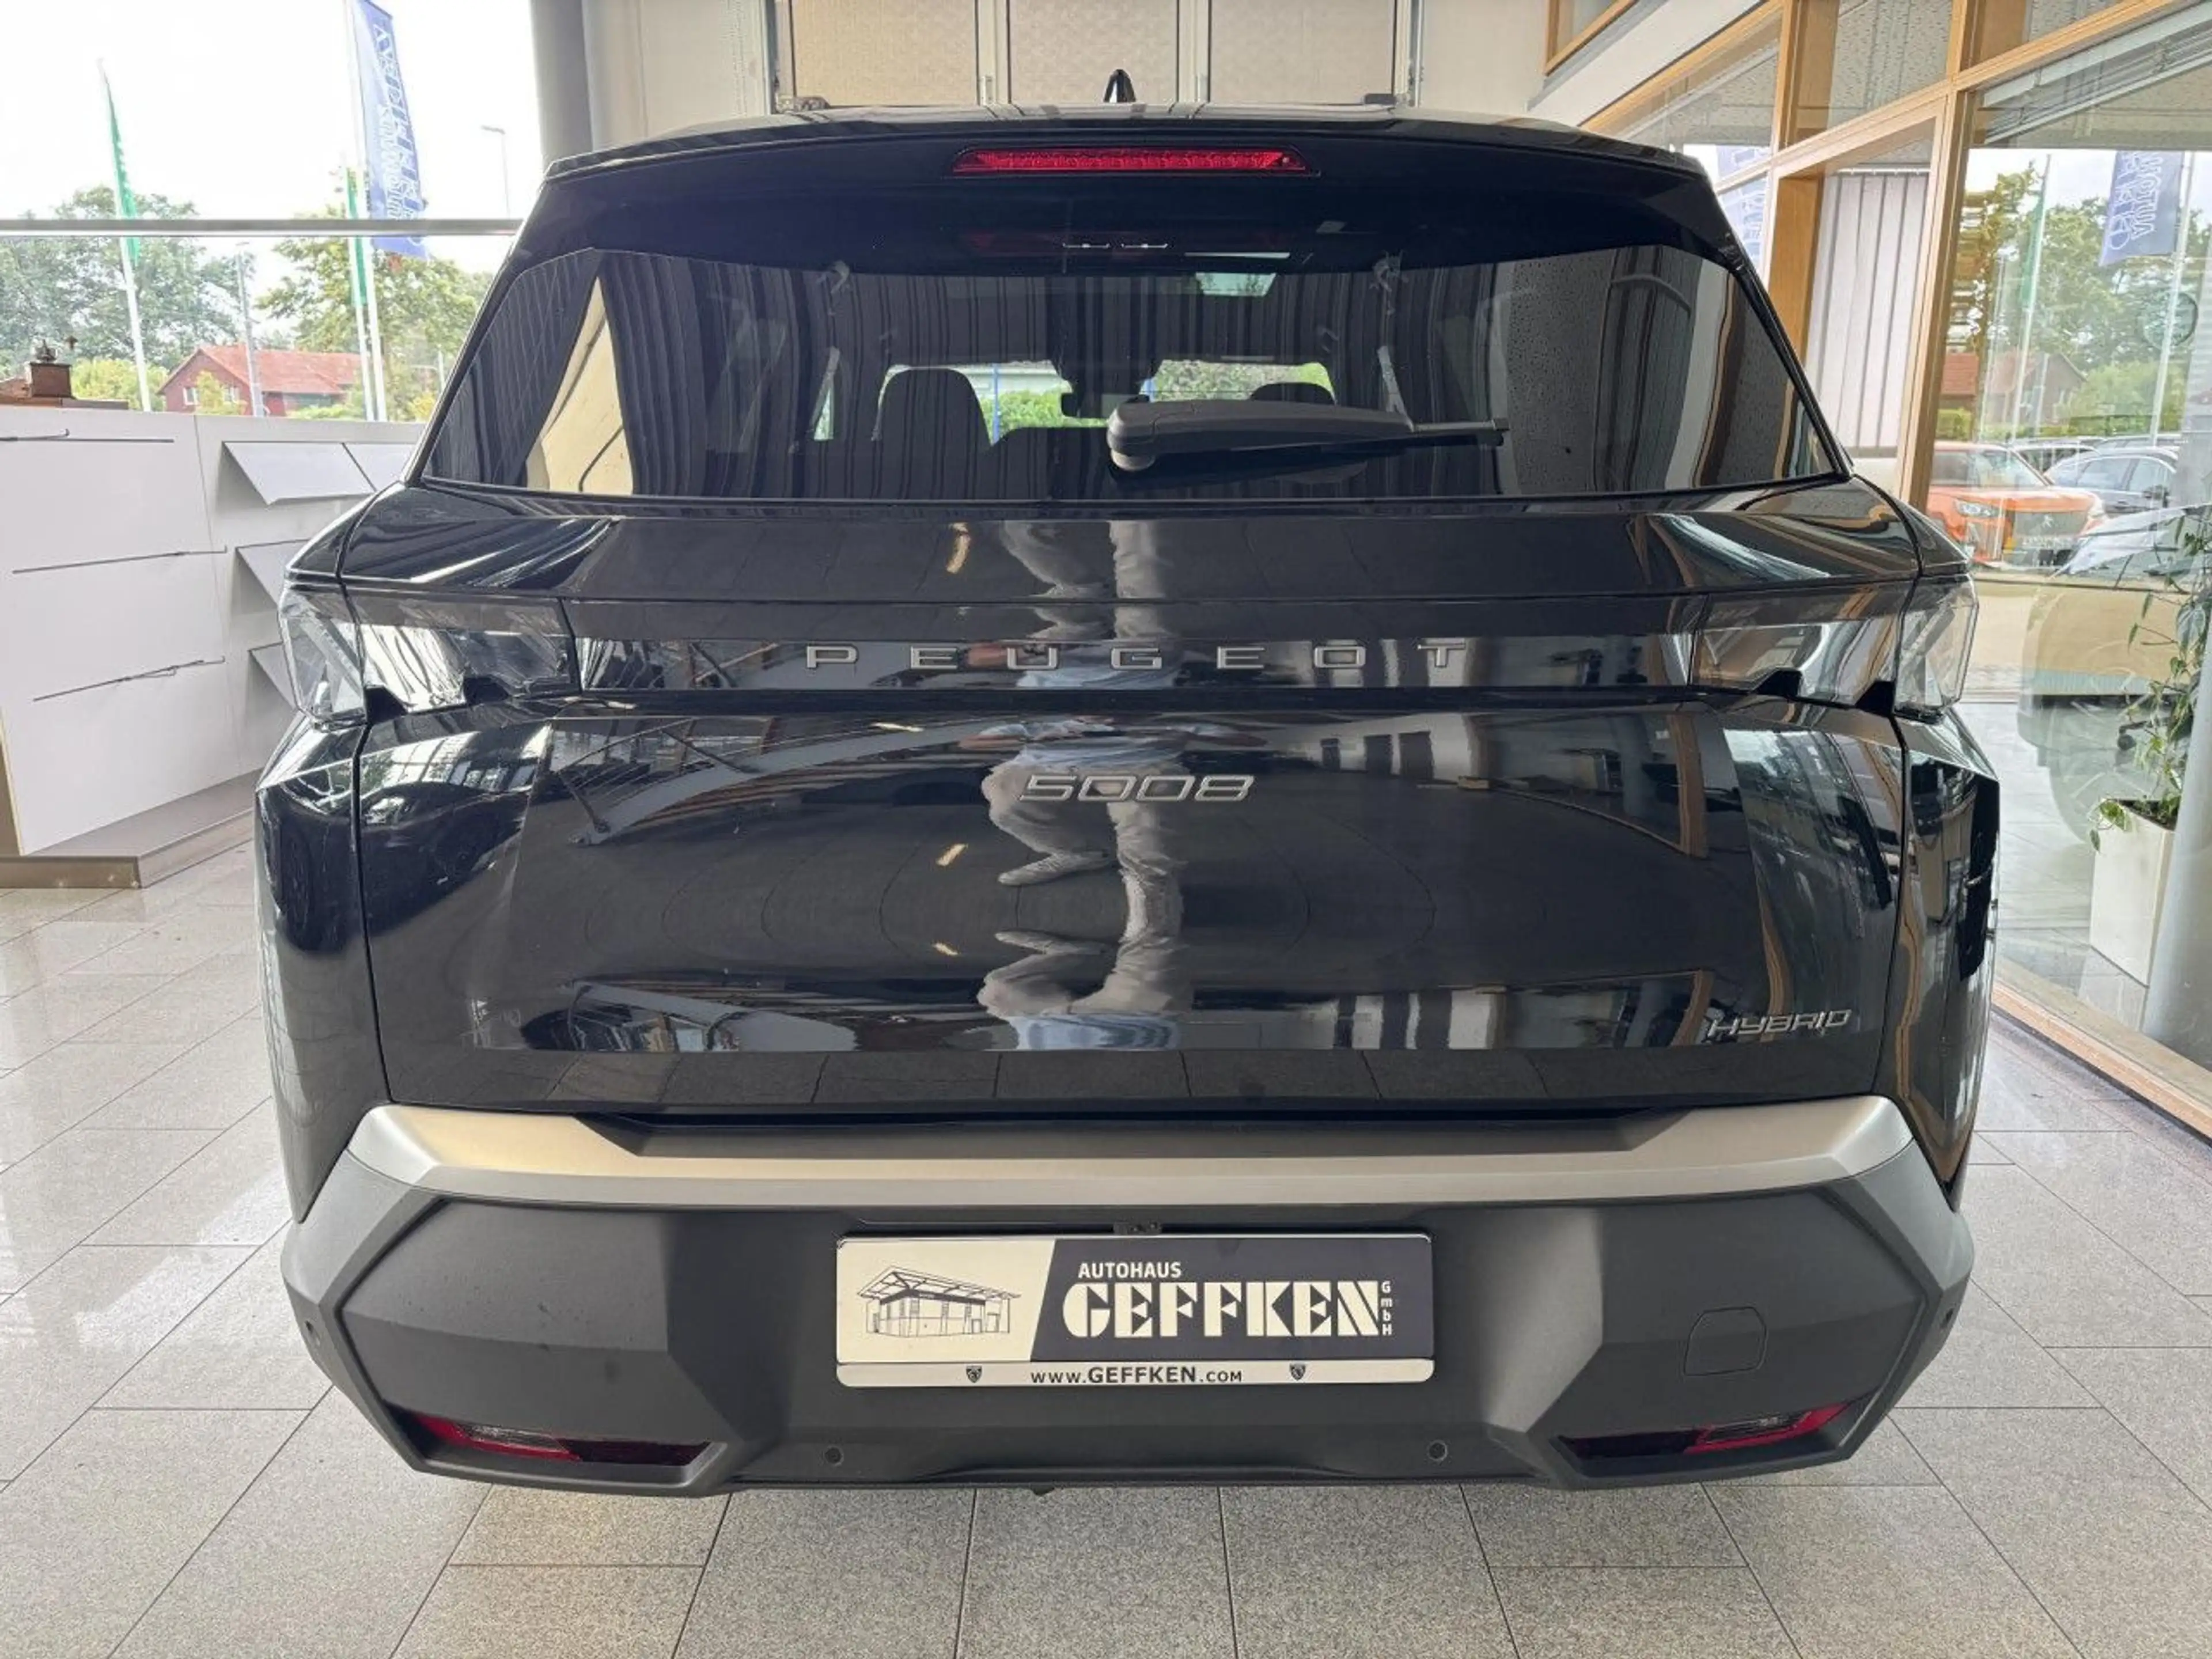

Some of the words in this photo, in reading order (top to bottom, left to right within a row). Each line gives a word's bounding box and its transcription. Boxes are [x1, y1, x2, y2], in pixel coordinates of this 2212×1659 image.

[806, 642, 1466, 671] PEUGEOT
[1019, 774, 1255, 802] 5008
[1707, 1009, 1852, 1037] HYBRID
[1078, 1262, 1182, 1279] AUTOHAUS
[1063, 1281, 1379, 1338] GEFFKEN
[1380, 1280, 1393, 1336] GmbH
